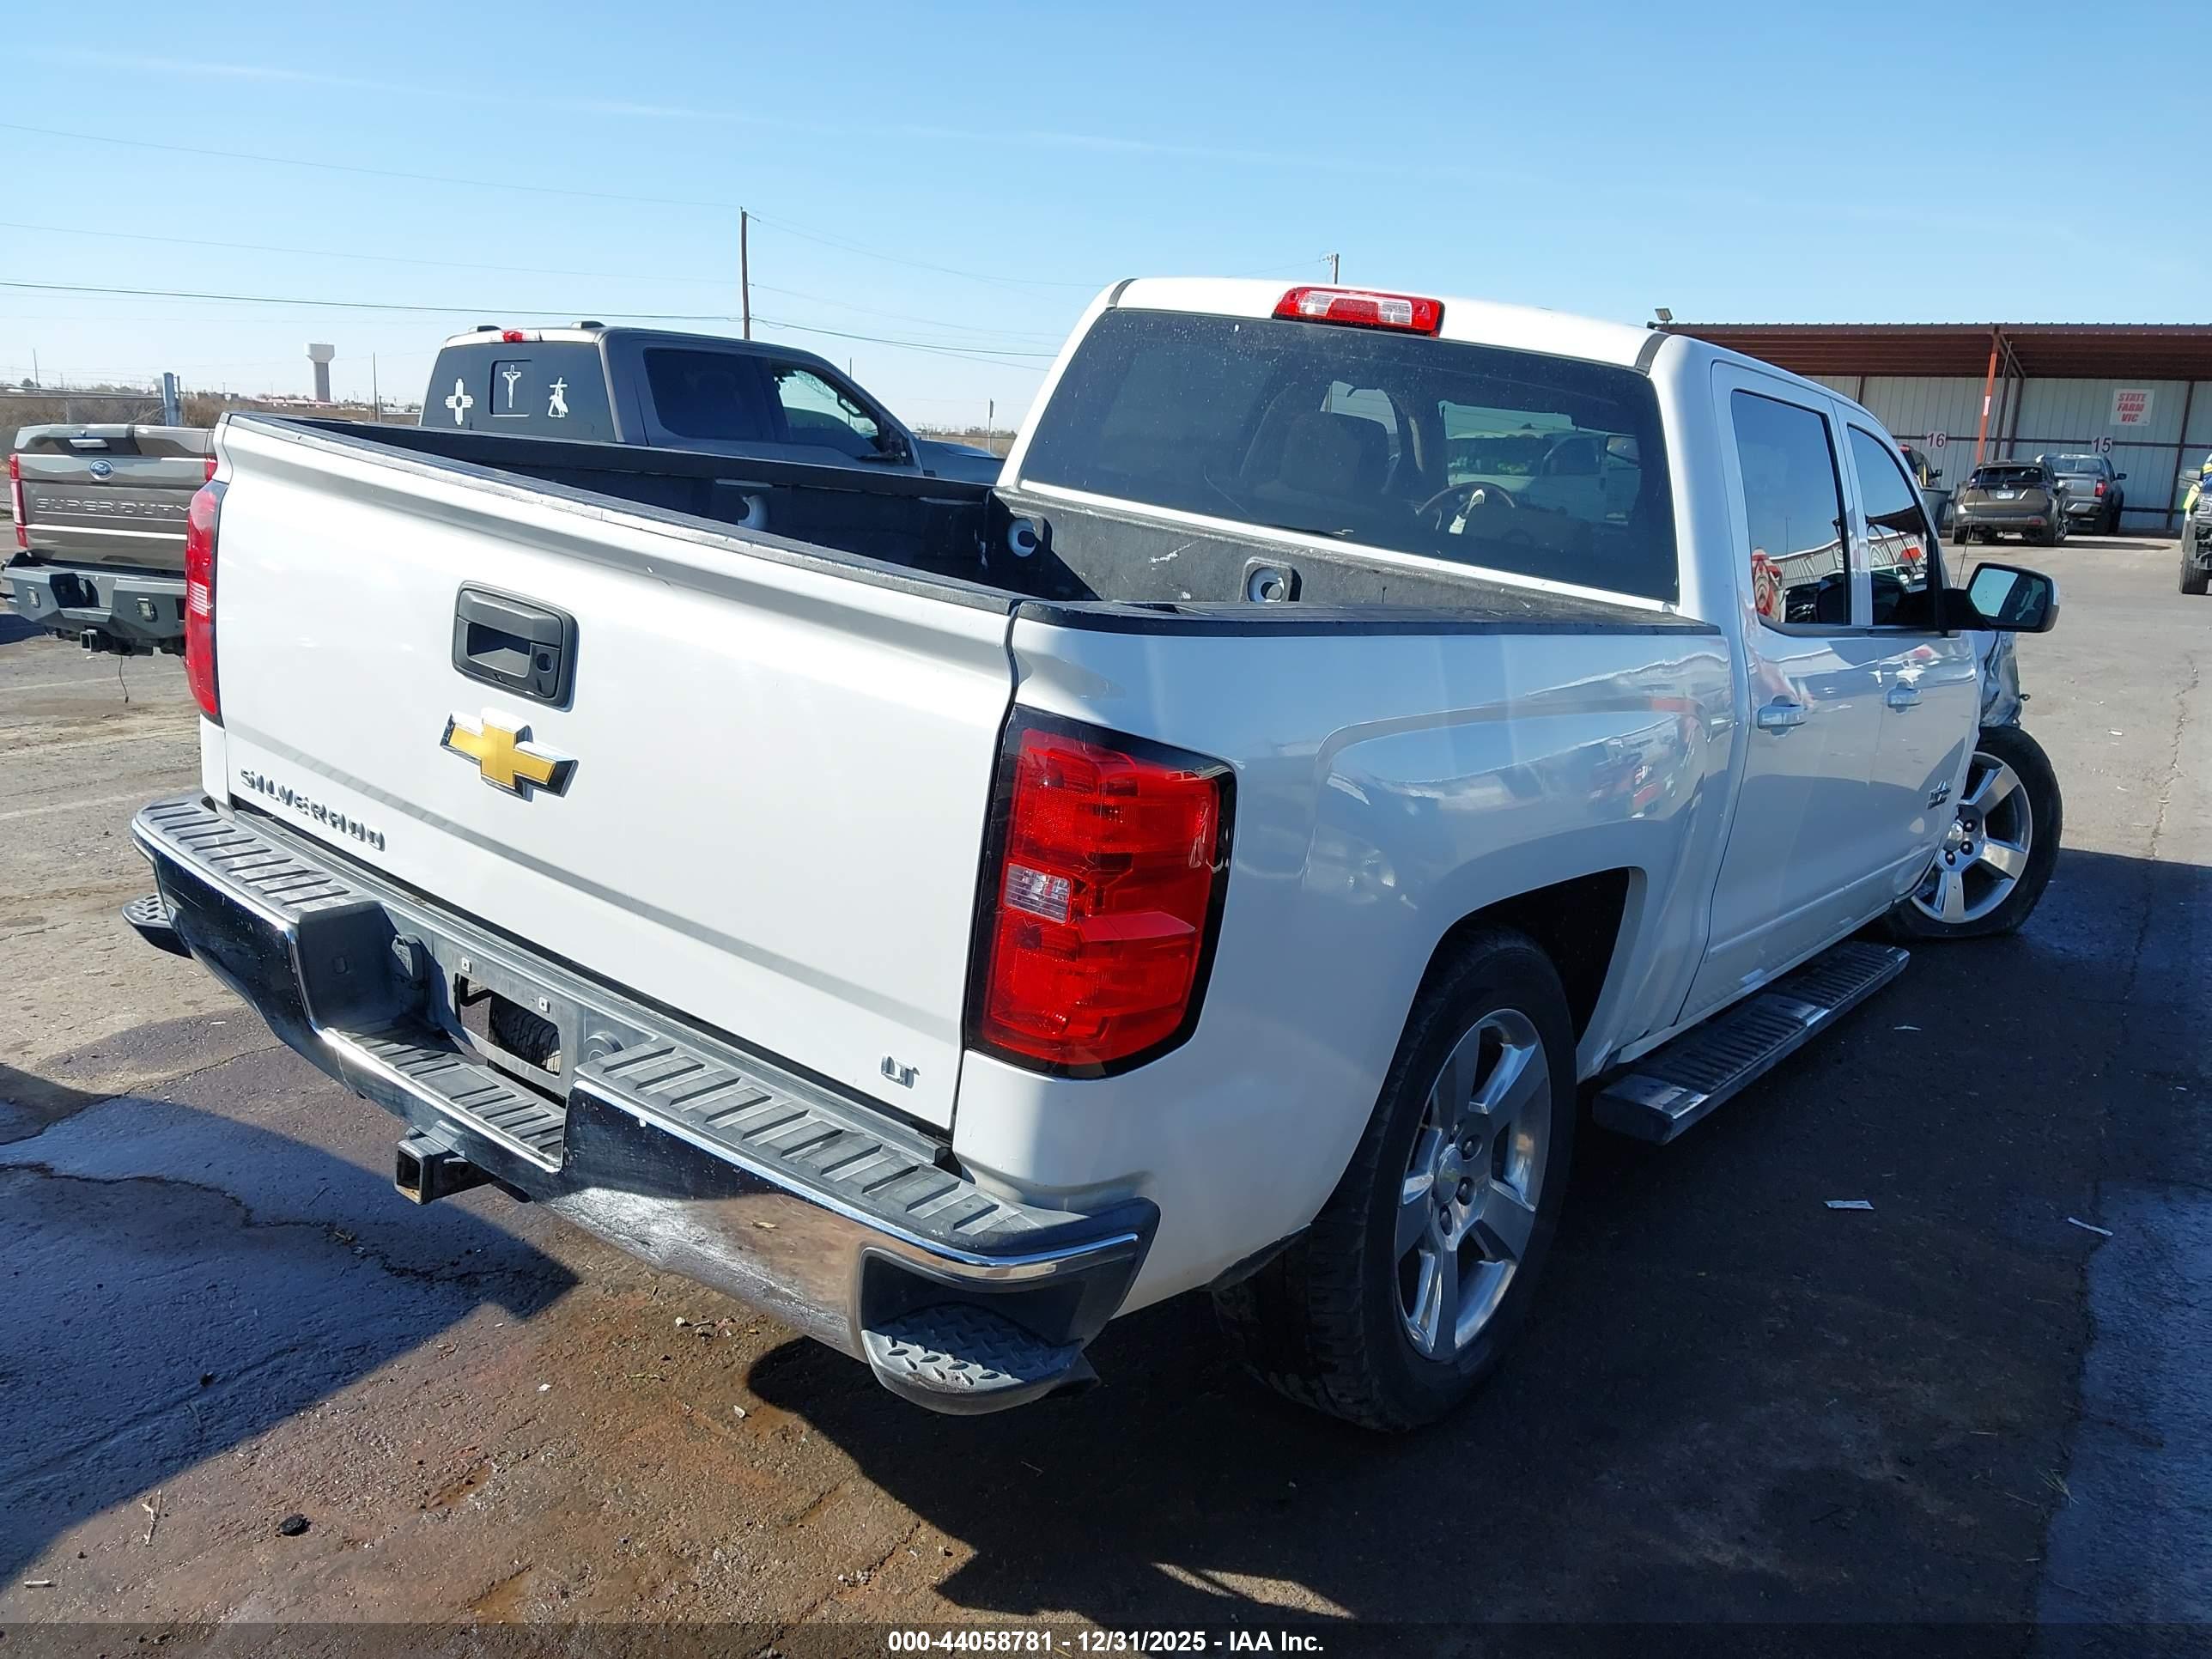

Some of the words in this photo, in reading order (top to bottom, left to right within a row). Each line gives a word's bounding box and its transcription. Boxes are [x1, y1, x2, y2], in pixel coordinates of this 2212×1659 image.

[2118, 392, 2147, 402] STATE
[2117, 403, 2145, 412] FARM
[2121, 413, 2139, 422] VIC
[1927, 432, 1945, 447] 16
[2093, 436, 2112, 453] 15
[36, 498, 115, 513] SUPER
[119, 501, 191, 515] DUTY
[240, 769, 386, 853] SILVERADO
[881, 1055, 921, 1090] LT
